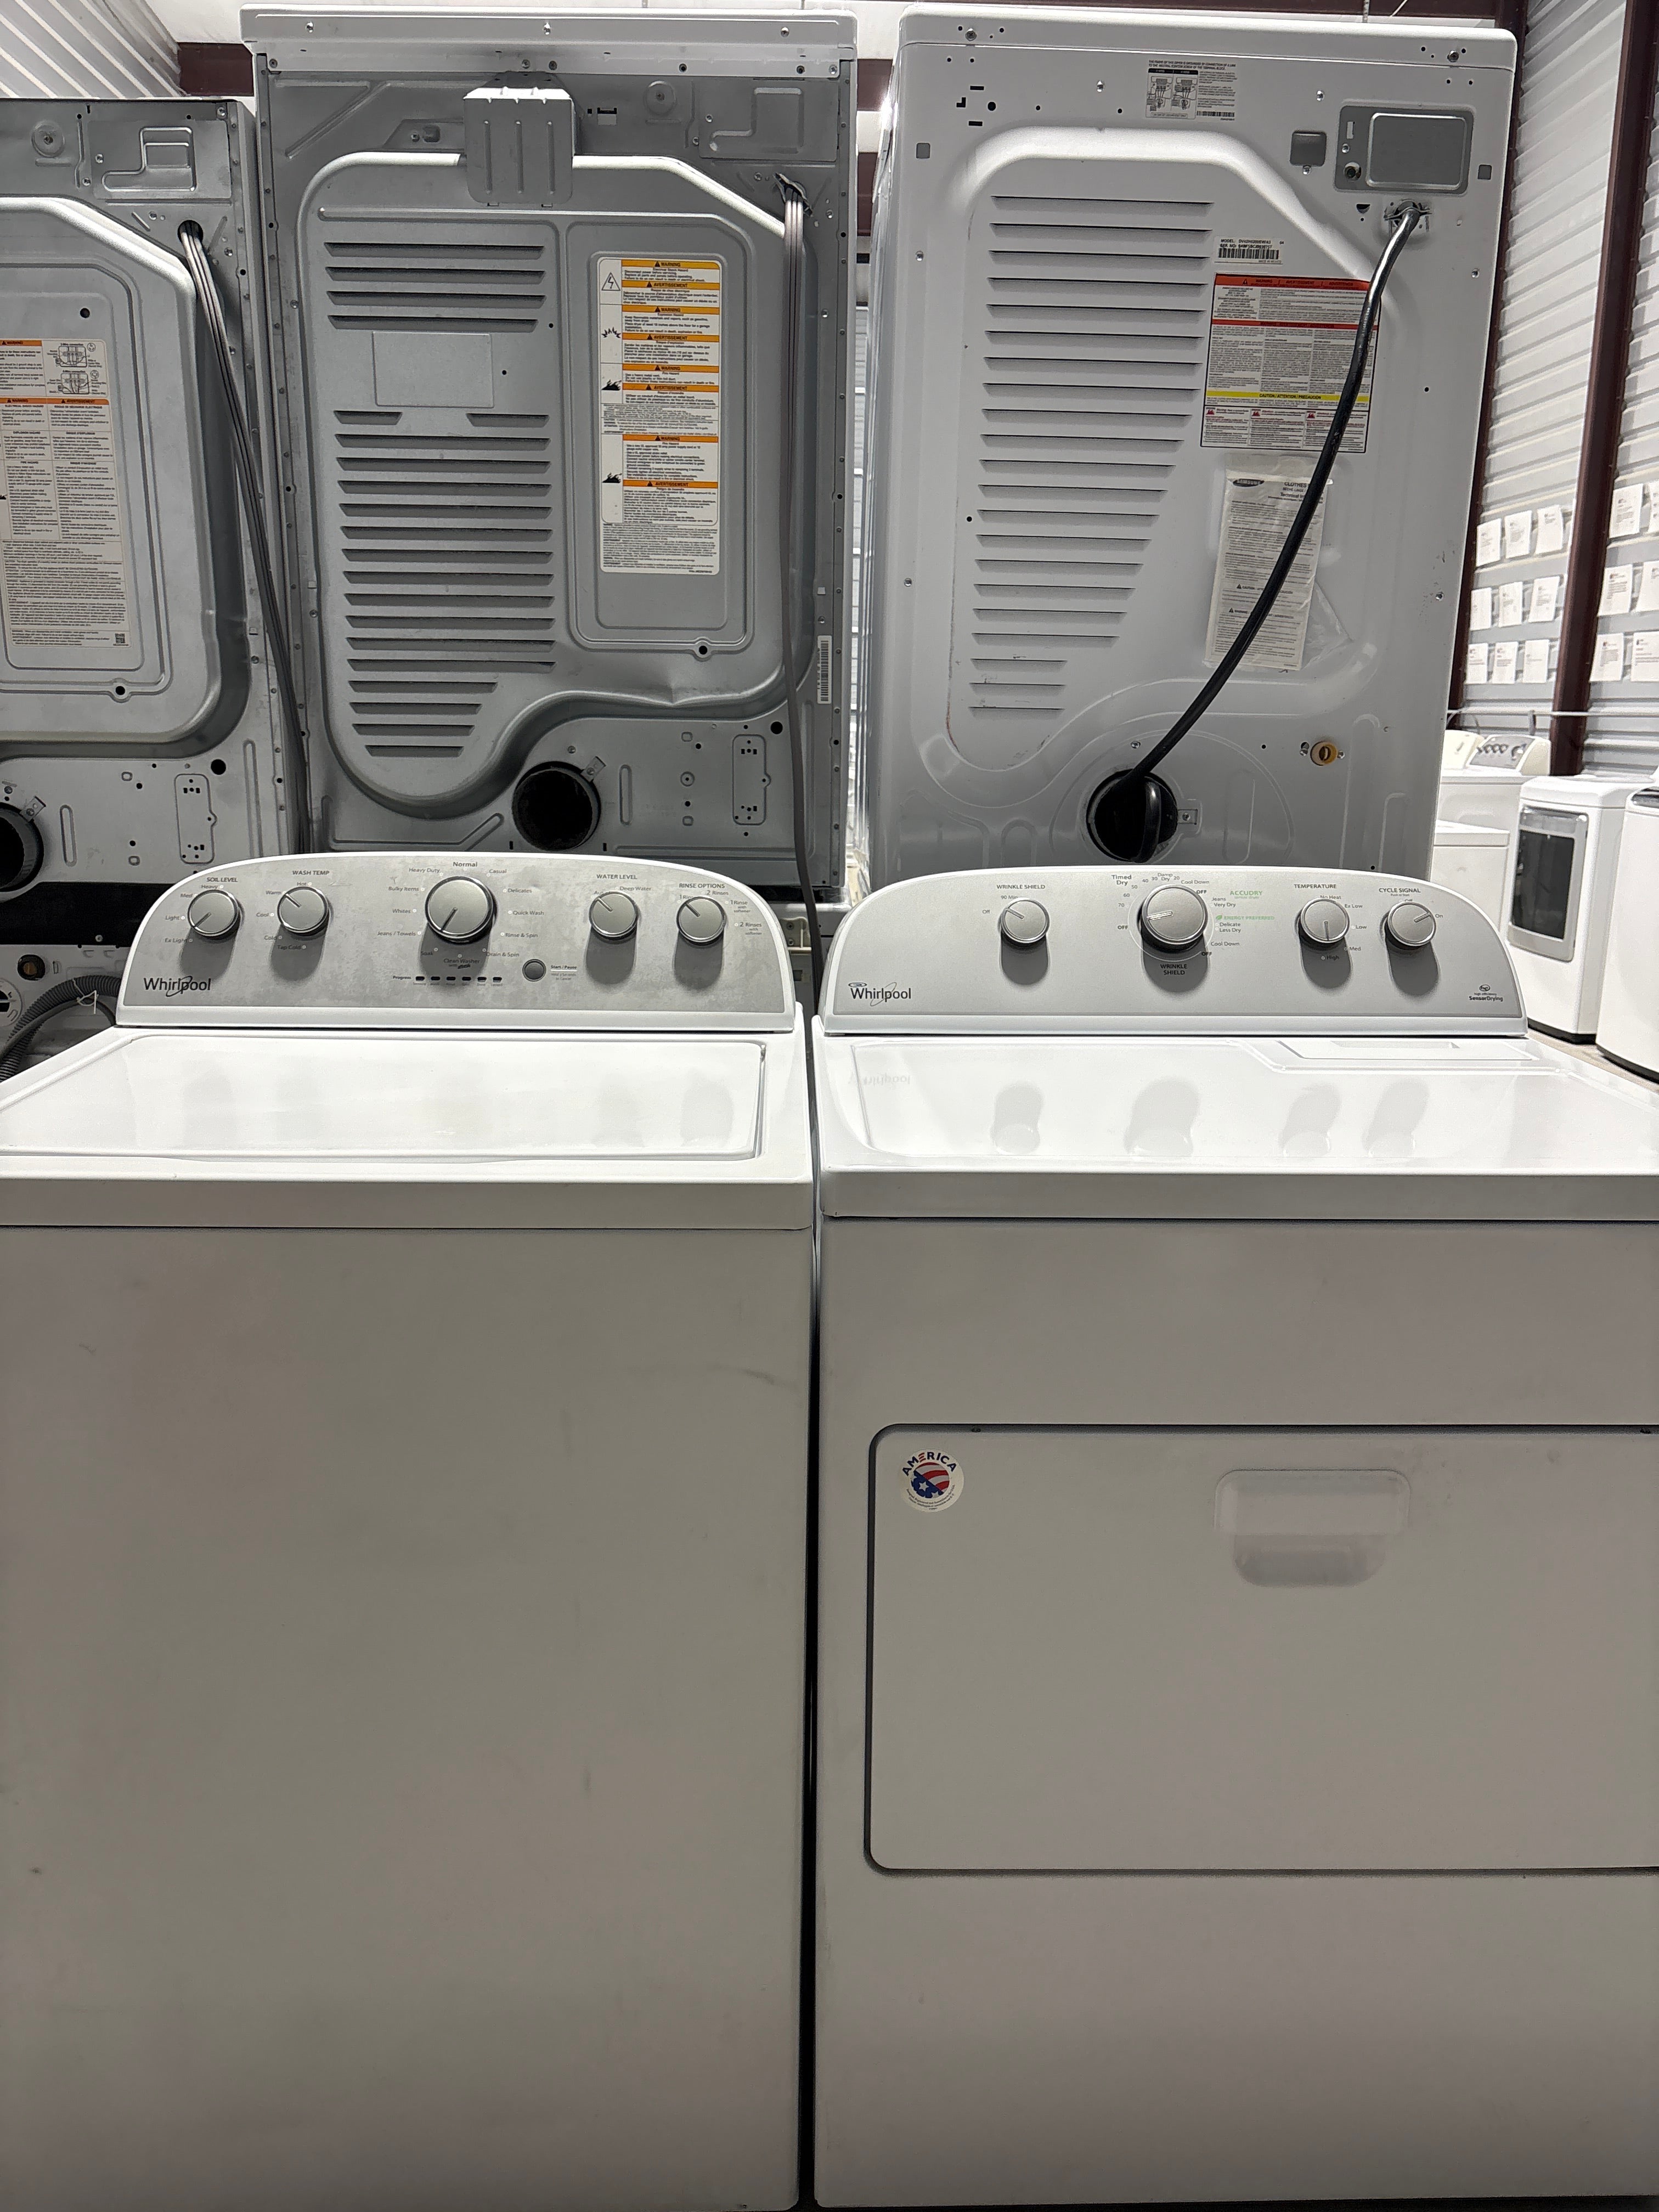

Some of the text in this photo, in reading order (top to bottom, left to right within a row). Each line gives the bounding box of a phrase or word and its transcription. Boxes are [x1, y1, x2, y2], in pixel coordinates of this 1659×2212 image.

[143, 977, 211, 996] Whirlpool
[850, 985, 911, 1004] Whirlpool
[902, 1451, 957, 1477] AMERICA
